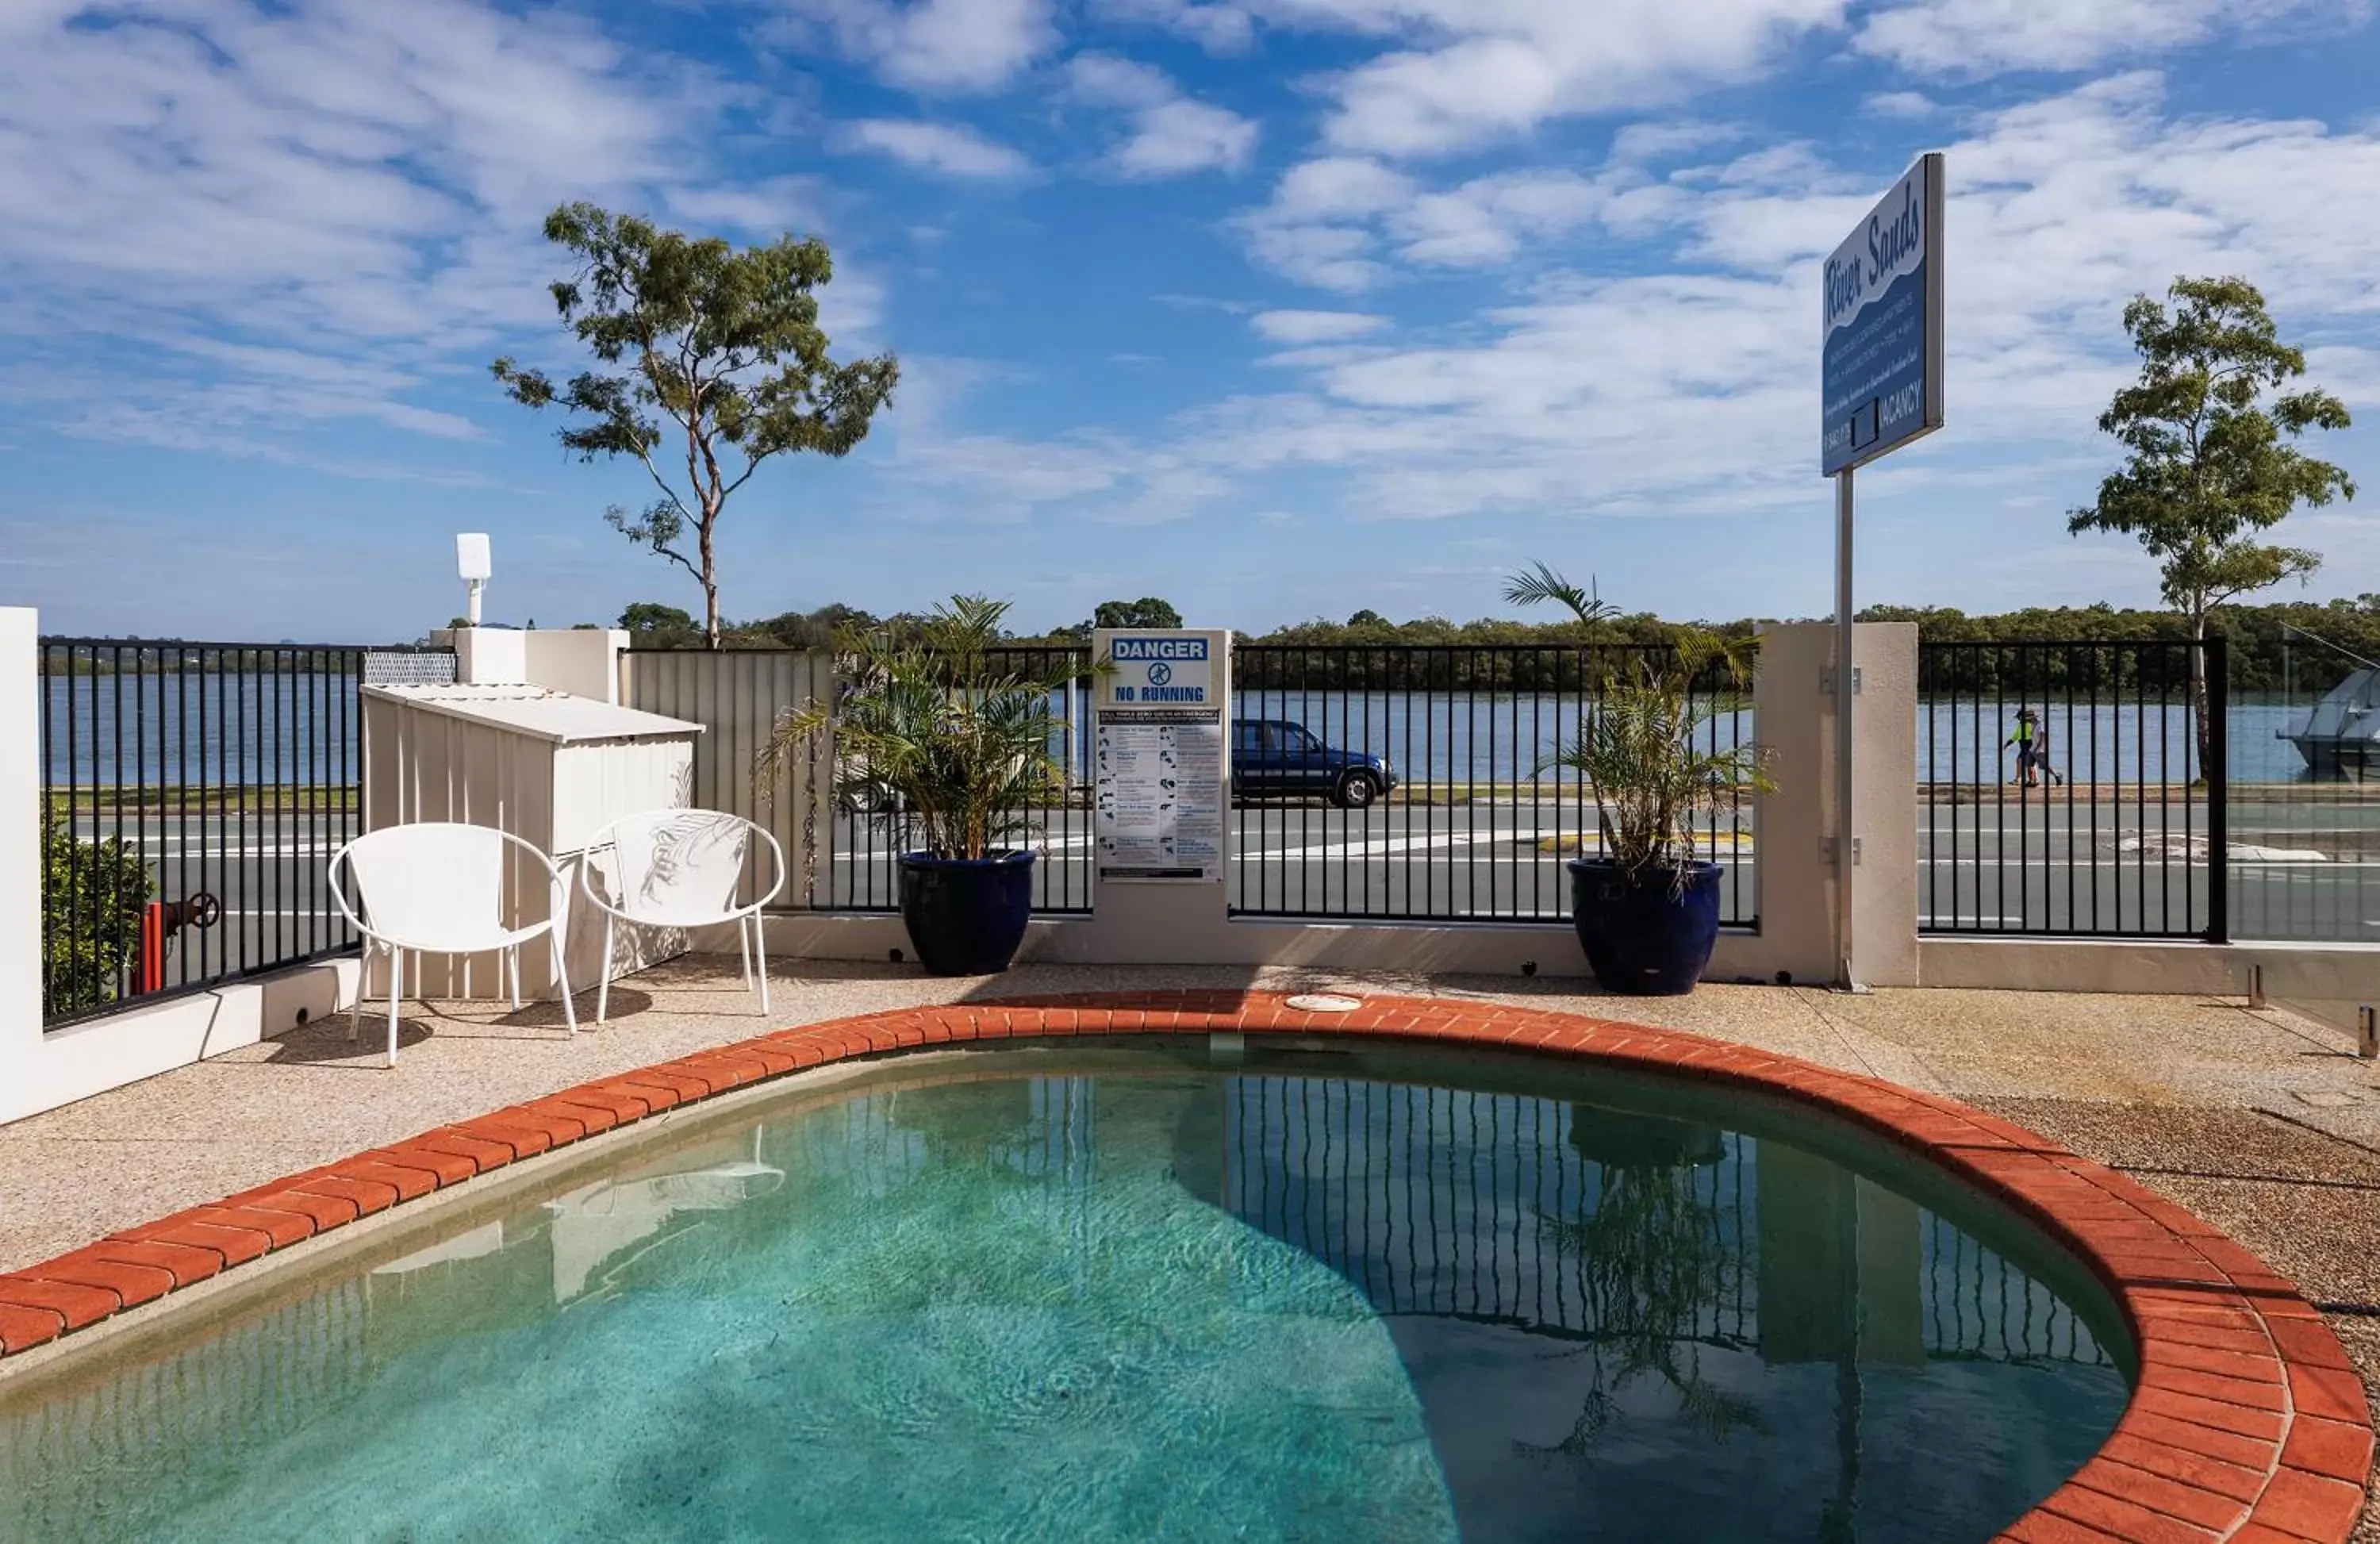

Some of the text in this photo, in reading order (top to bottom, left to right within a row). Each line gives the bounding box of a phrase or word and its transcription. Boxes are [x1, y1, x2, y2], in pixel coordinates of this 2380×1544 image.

[1826, 254, 1862, 325] River
[1868, 181, 1919, 286] Sands
[1879, 378, 1921, 430] VACANCY
[1115, 641, 1203, 658] DANGER
[1115, 686, 1203, 701] NO RUNNING
